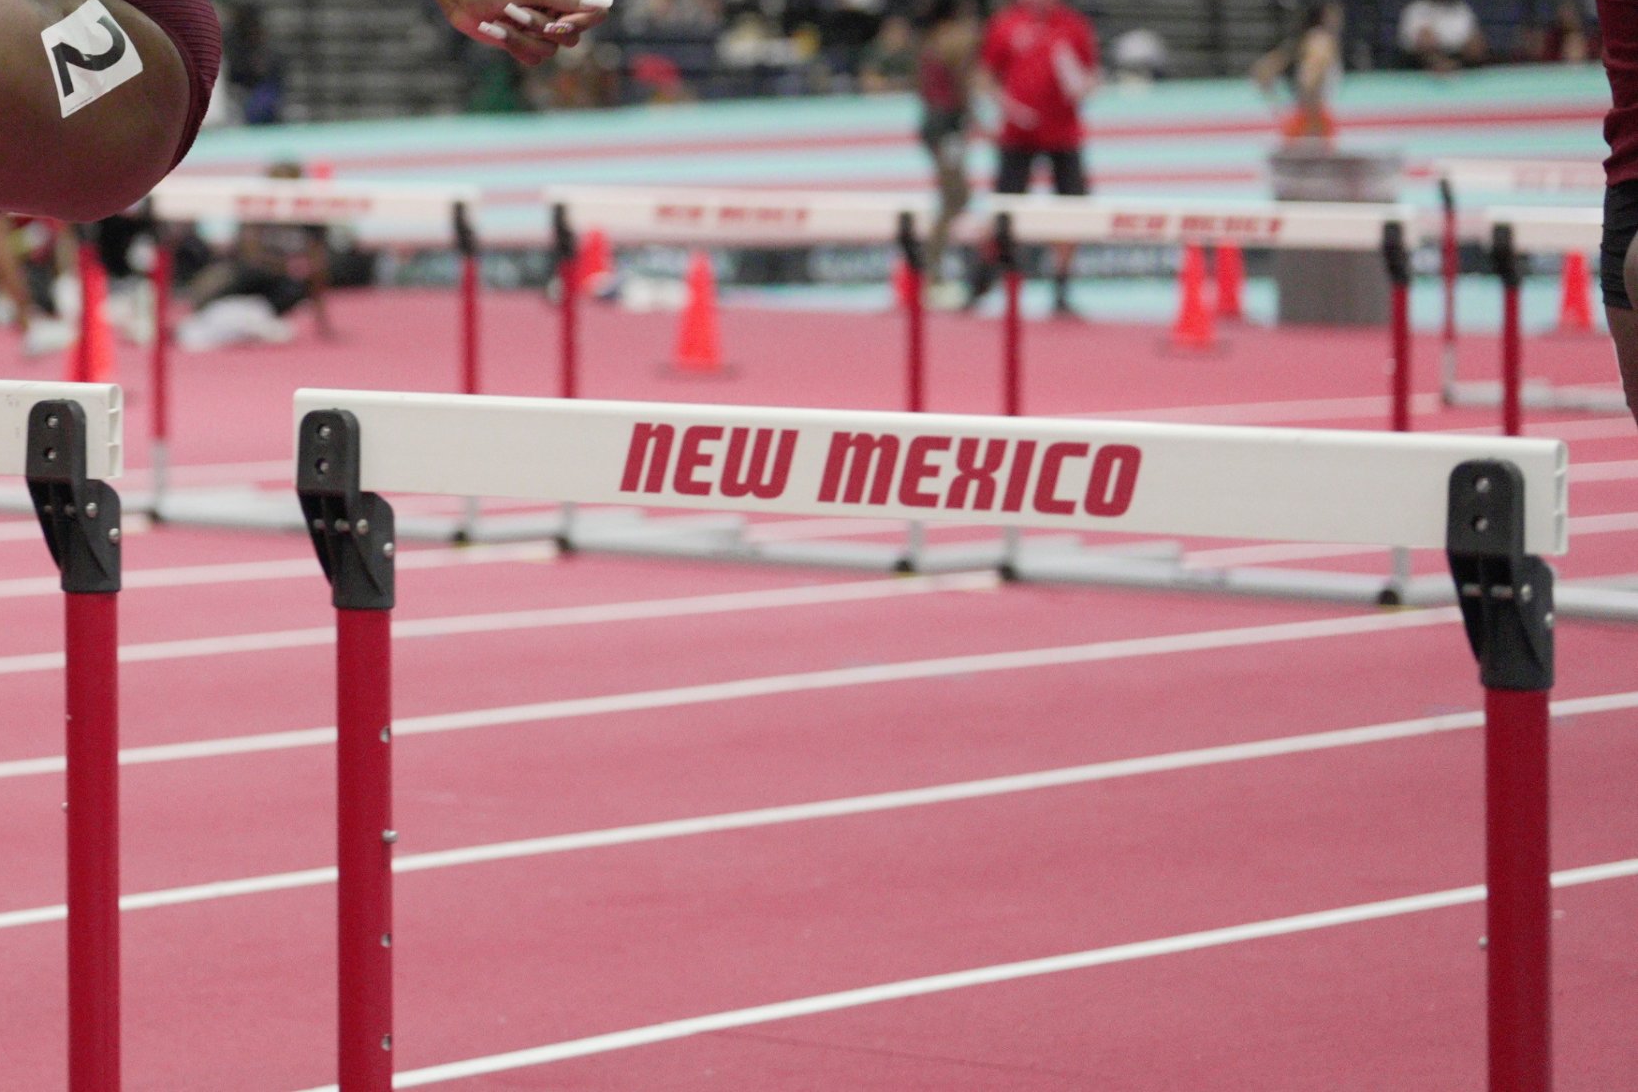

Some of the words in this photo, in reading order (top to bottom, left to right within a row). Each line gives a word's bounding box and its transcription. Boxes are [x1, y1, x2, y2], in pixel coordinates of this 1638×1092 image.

[51, 15, 126, 98] 2
[619, 422, 799, 500] NEW
[817, 431, 1142, 518] MEXICO
